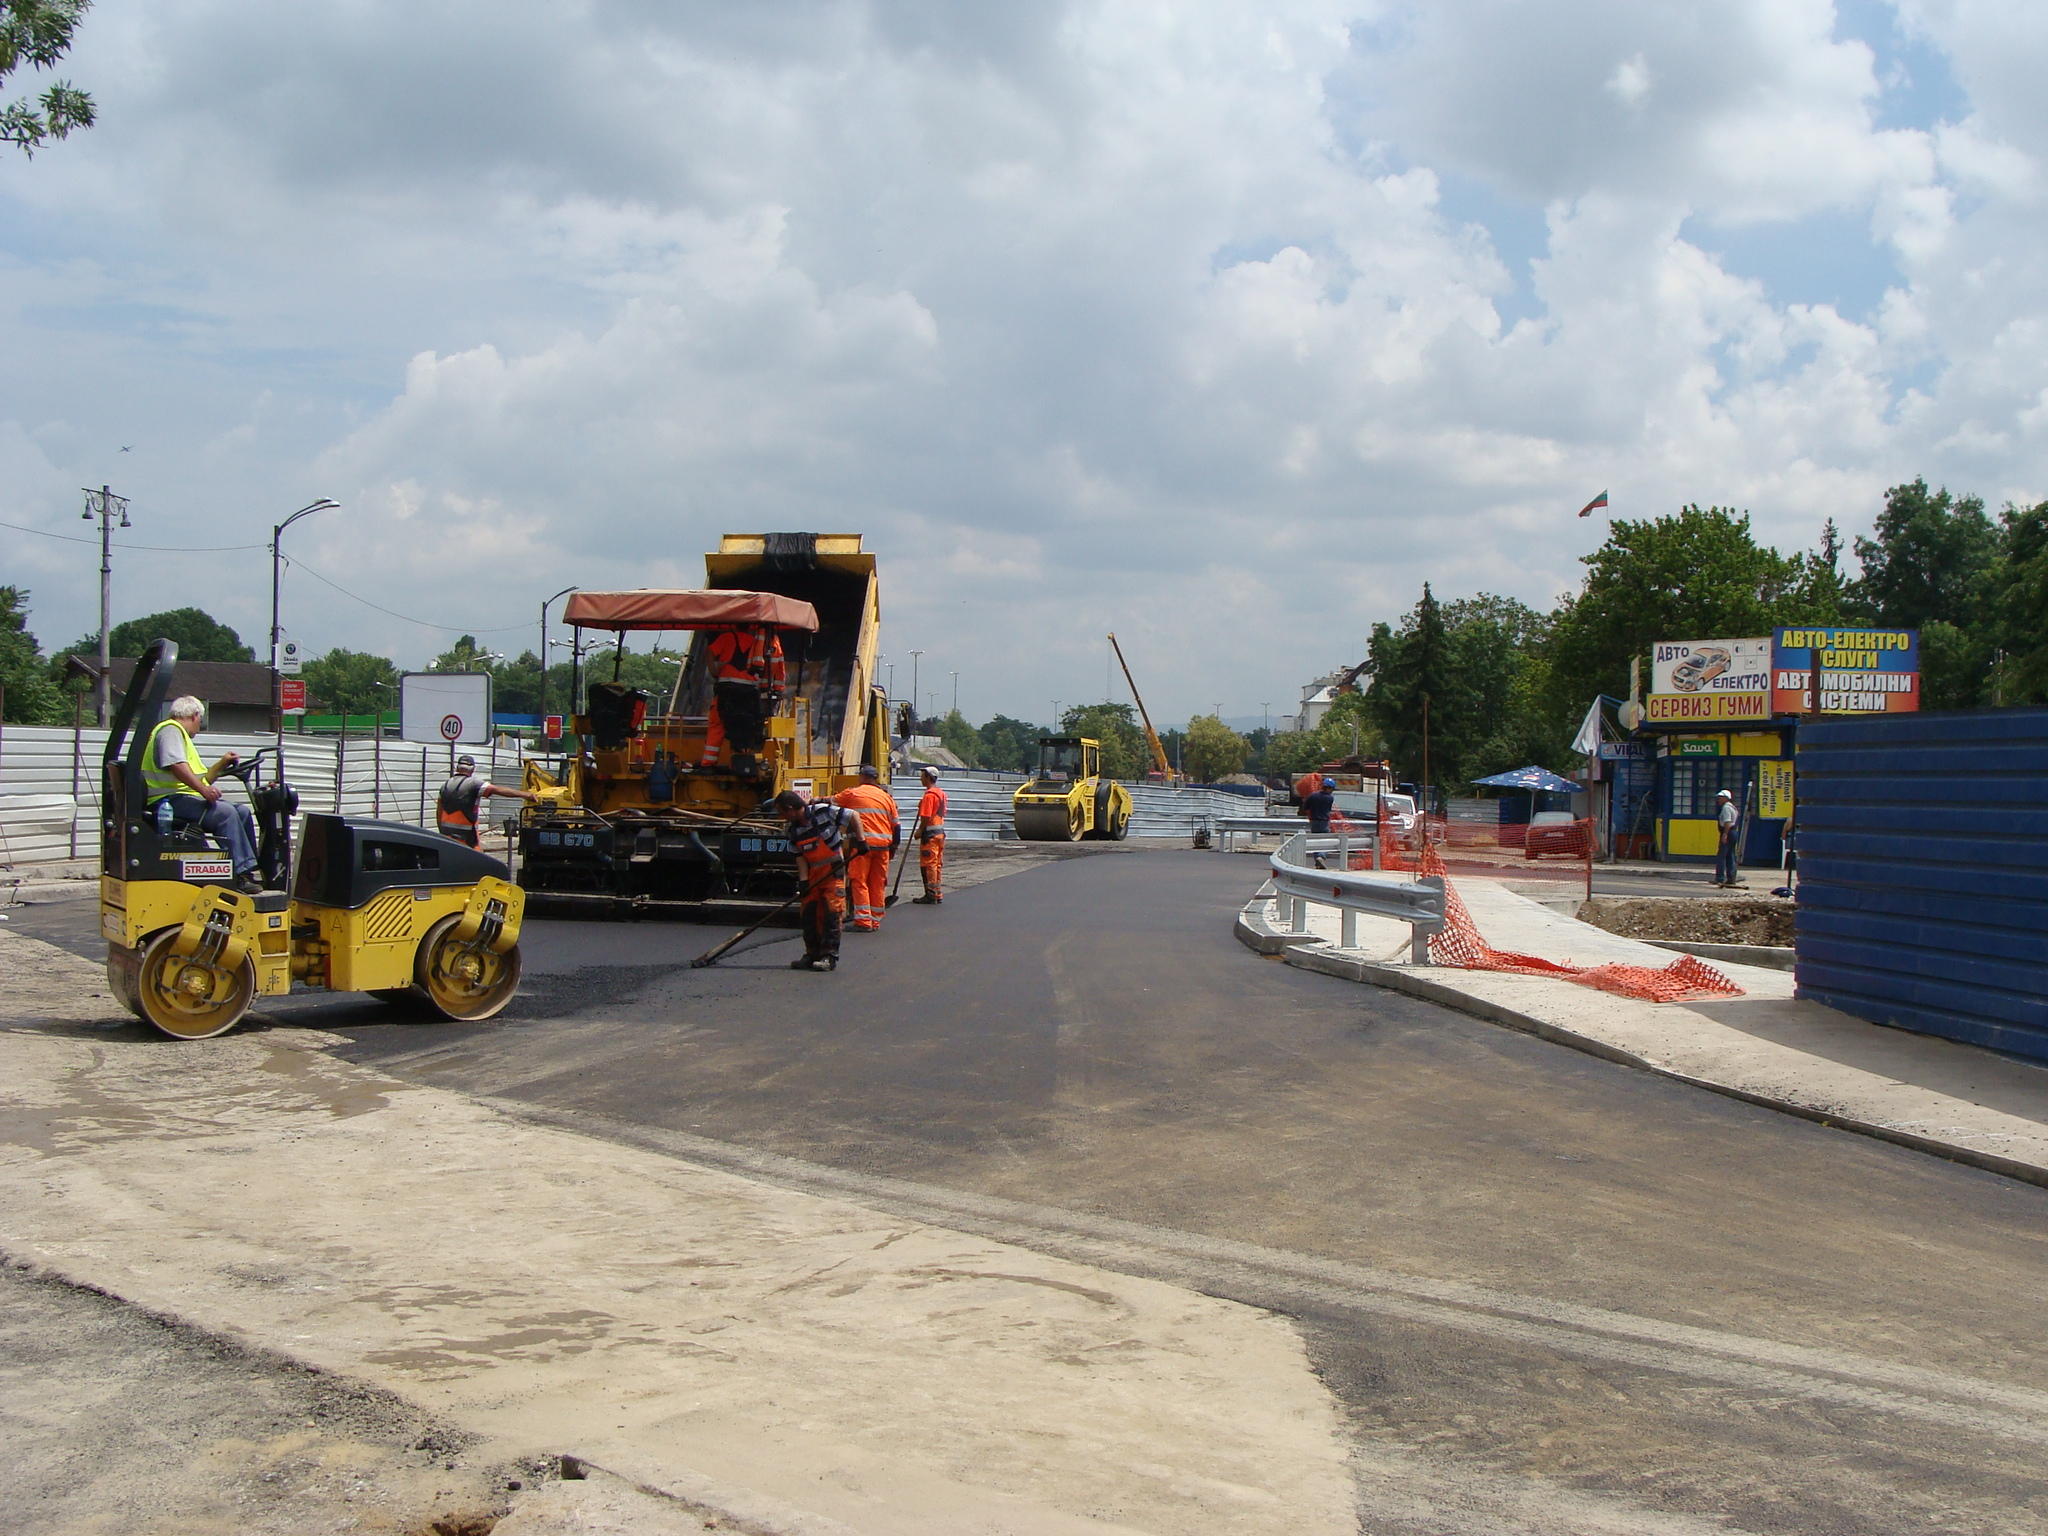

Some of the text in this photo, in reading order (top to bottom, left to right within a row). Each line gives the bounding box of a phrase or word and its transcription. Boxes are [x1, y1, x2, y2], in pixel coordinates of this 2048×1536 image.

[1781, 630, 1909, 651] АВТО-ЕЛЕКТРО
[1656, 646, 1690, 663] АВТО
[1819, 650, 1878, 668] СЛУГИ
[1712, 672, 1769, 690] ЕЛЕКТРО
[1777, 672, 1912, 692] АВТМОБИЛНИ
[1650, 695, 1763, 718] СЕРВИЗ ГУМИ
[445, 721, 459, 734] 40
[1683, 743, 1712, 753] Sava
[185, 865, 231, 874] STRABAG
